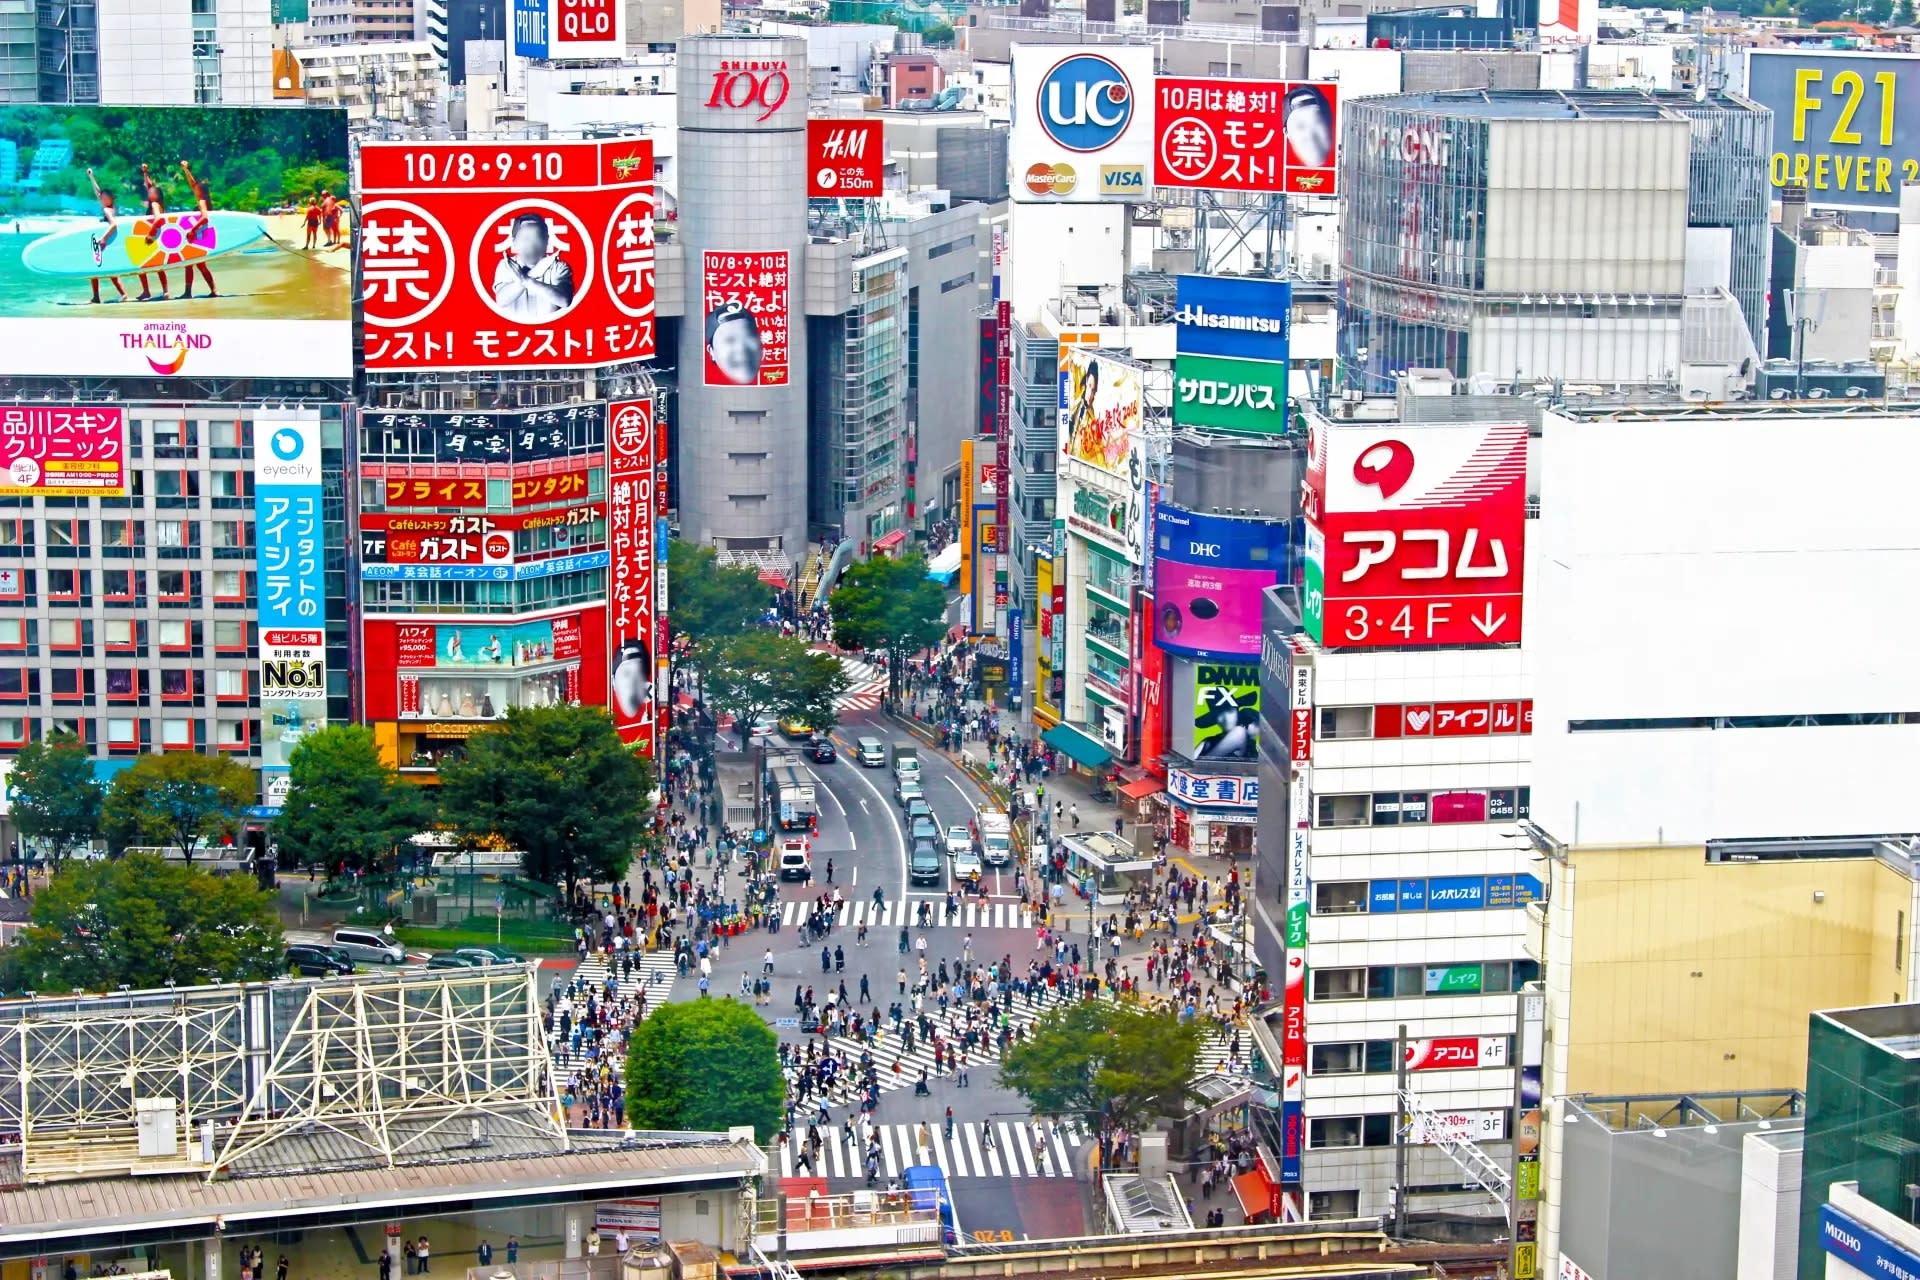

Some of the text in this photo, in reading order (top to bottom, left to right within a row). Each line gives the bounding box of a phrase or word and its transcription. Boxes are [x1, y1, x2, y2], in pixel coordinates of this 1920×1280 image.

[516, 10, 546, 45] PRIME
[564, 12, 609, 37] QLO
[720, 60, 787, 70] SHIBUYA
[704, 71, 790, 122] 109
[1161, 87, 1277, 113] 10月は絶対!
[1792, 68, 1896, 146] F21
[822, 129, 868, 160] H&M
[1223, 120, 1275, 149] モン
[1172, 126, 1206, 169] 禁
[839, 167, 865, 176] この先
[1026, 174, 1077, 184] MasterCard
[1104, 171, 1143, 186] VISA
[1220, 154, 1275, 184] スト!
[839, 177, 873, 189] 150m
[362, 219, 430, 303] 禁
[706, 272, 787, 287] モンスト絶対
[706, 290, 787, 312] やるなよ!
[144, 321, 186, 333] amazing
[1175, 303, 1281, 334] Hisamitsu
[120, 333, 212, 350] THAILAND
[473, 328, 593, 358] モンスト!
[761, 330, 787, 344] 絶対
[1178, 377, 1276, 411] サロンパス
[3, 410, 118, 436] 品川スキン
[377, 414, 423, 427] 月の宴
[445, 415, 490, 428] 月の宴
[619, 414, 642, 446] 禁
[4, 436, 118, 459] クリニック
[445, 434, 506, 453] 月の宴
[520, 429, 564, 450] 月の宴
[263, 463, 312, 478] eyecity
[613, 454, 648, 469] モンスト!
[18, 474, 32, 483] 4F
[512, 473, 585, 499] コンタクト
[387, 482, 483, 500] プライス
[449, 516, 495, 534] ガスト
[567, 507, 600, 526] ガスト
[363, 540, 385, 554] 7F
[391, 540, 416, 550] Café
[420, 537, 477, 560] ガスト
[1190, 541, 1221, 557] DHC
[263, 497, 293, 617] アイシティ
[296, 497, 317, 617] コンタクトの
[520, 554, 608, 575] AEON 英会話イーオン
[632, 479, 651, 641] 10月はモンスト
[1342, 529, 1509, 582] アコム
[366, 566, 394, 576] AEON
[404, 567, 488, 577] 英会話イーオン
[272, 633, 317, 644] 当ビル5階
[400, 628, 429, 637] ハワイ
[262, 661, 323, 688] No.1
[1198, 666, 1260, 685] DMM
[263, 689, 322, 697] コンタクトショップ
[1197, 686, 1239, 706] FX
[1437, 708, 1514, 728] アイフル
[1297, 721, 1306, 759] アイフル
[1431, 886, 1480, 900] レオパレス21
[1291, 911, 1301, 942] レイク
[1449, 974, 1477, 984] レイク
[1288, 1006, 1300, 1040] アコム
[1433, 1046, 1475, 1061] アコム
[1485, 1046, 1503, 1057] 4F
[1482, 1119, 1501, 1131] 3F
[1824, 1221, 1861, 1252] MIZUHO
